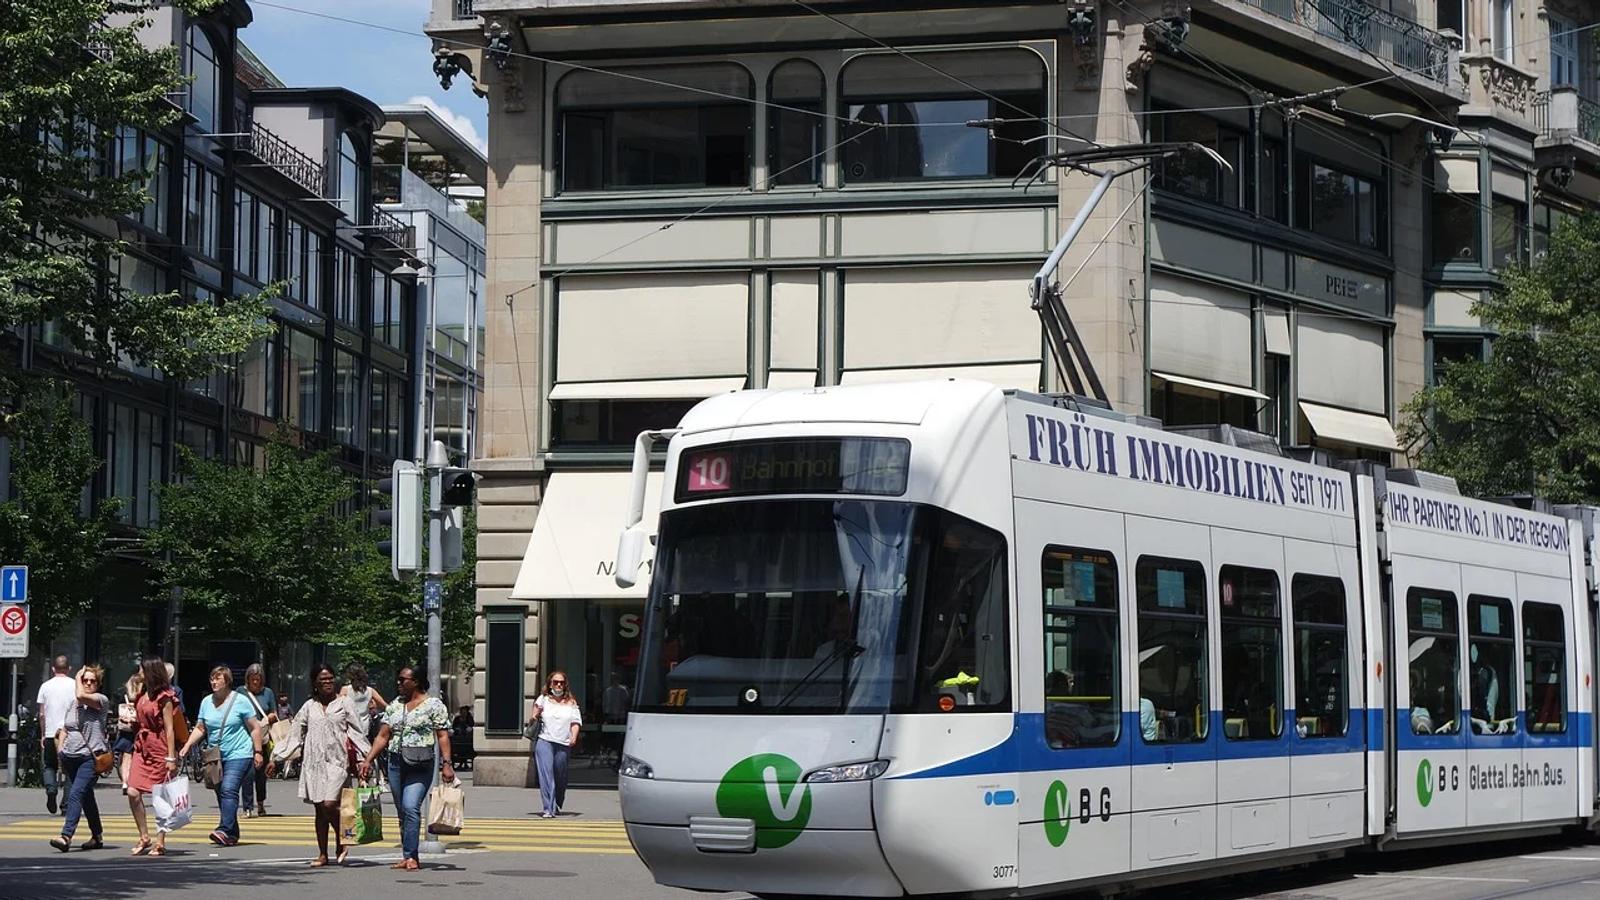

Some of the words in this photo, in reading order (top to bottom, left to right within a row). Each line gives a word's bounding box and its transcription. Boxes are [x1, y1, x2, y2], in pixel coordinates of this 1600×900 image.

[696, 456, 728, 487] 10
[1026, 413, 1118, 476] FRÜH
[1126, 436, 1286, 505] IMMOBILIEN
[1290, 470, 1315, 506] SEIT
[1317, 476, 1346, 512] 1971
[1389, 491, 1411, 523] IHR
[1412, 496, 1462, 533] PARTNER
[1492, 511, 1505, 541] IN
[1506, 514, 1528, 544] DER
[1528, 519, 1568, 552] REGION
[992, 864, 1015, 879] 3077
